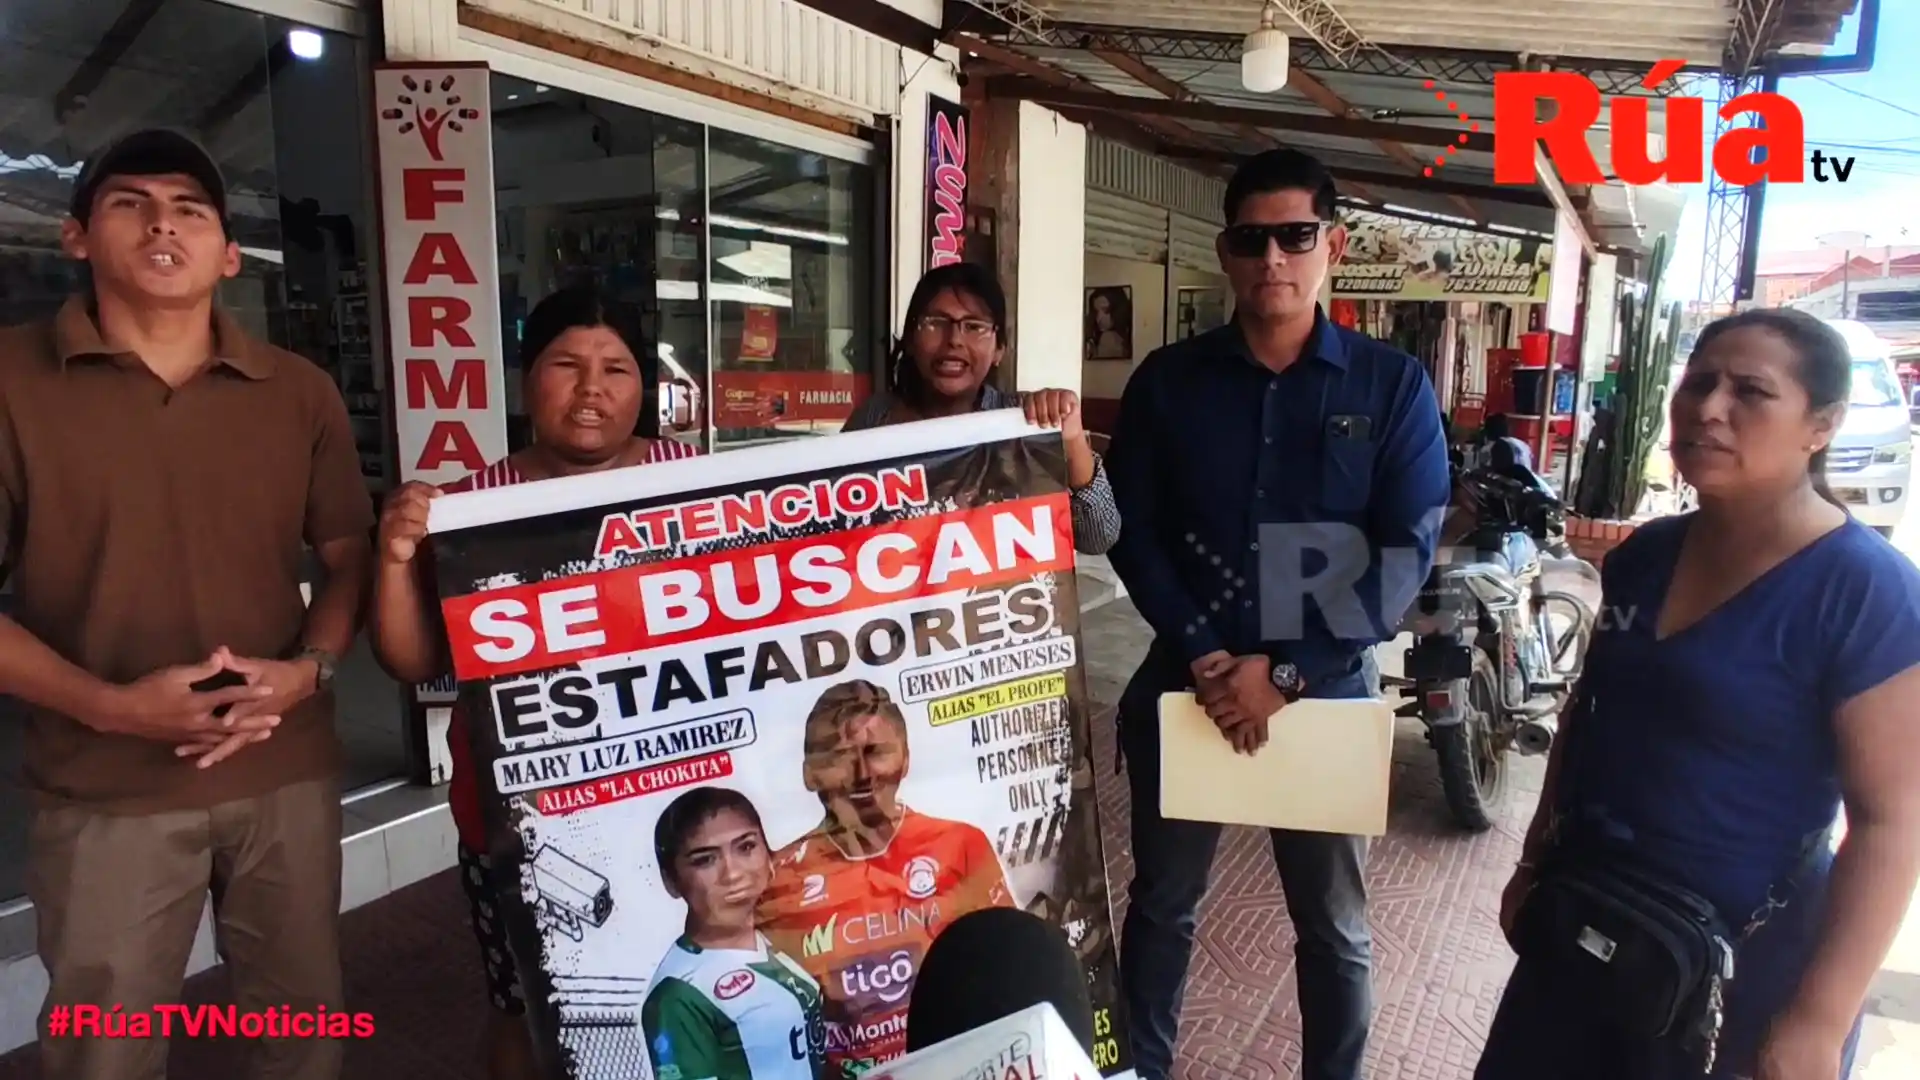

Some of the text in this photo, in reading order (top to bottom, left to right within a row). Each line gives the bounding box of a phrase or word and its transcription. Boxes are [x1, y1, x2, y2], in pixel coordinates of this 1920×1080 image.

[1449, 261, 1532, 278] ZUMBA
[799, 390, 852, 405] FARMACIA
[597, 464, 929, 558] ATENCION
[469, 504, 1057, 664] SE BUSCAN
[906, 640, 1072, 697] ERWIN MENESES
[931, 698, 976, 723] ALIAS
[501, 716, 748, 787] MARY LUZ RAMIREZ
[541, 785, 598, 813] ALIAS
[1008, 779, 1049, 813] ONLY
[842, 901, 942, 945] CELINA
